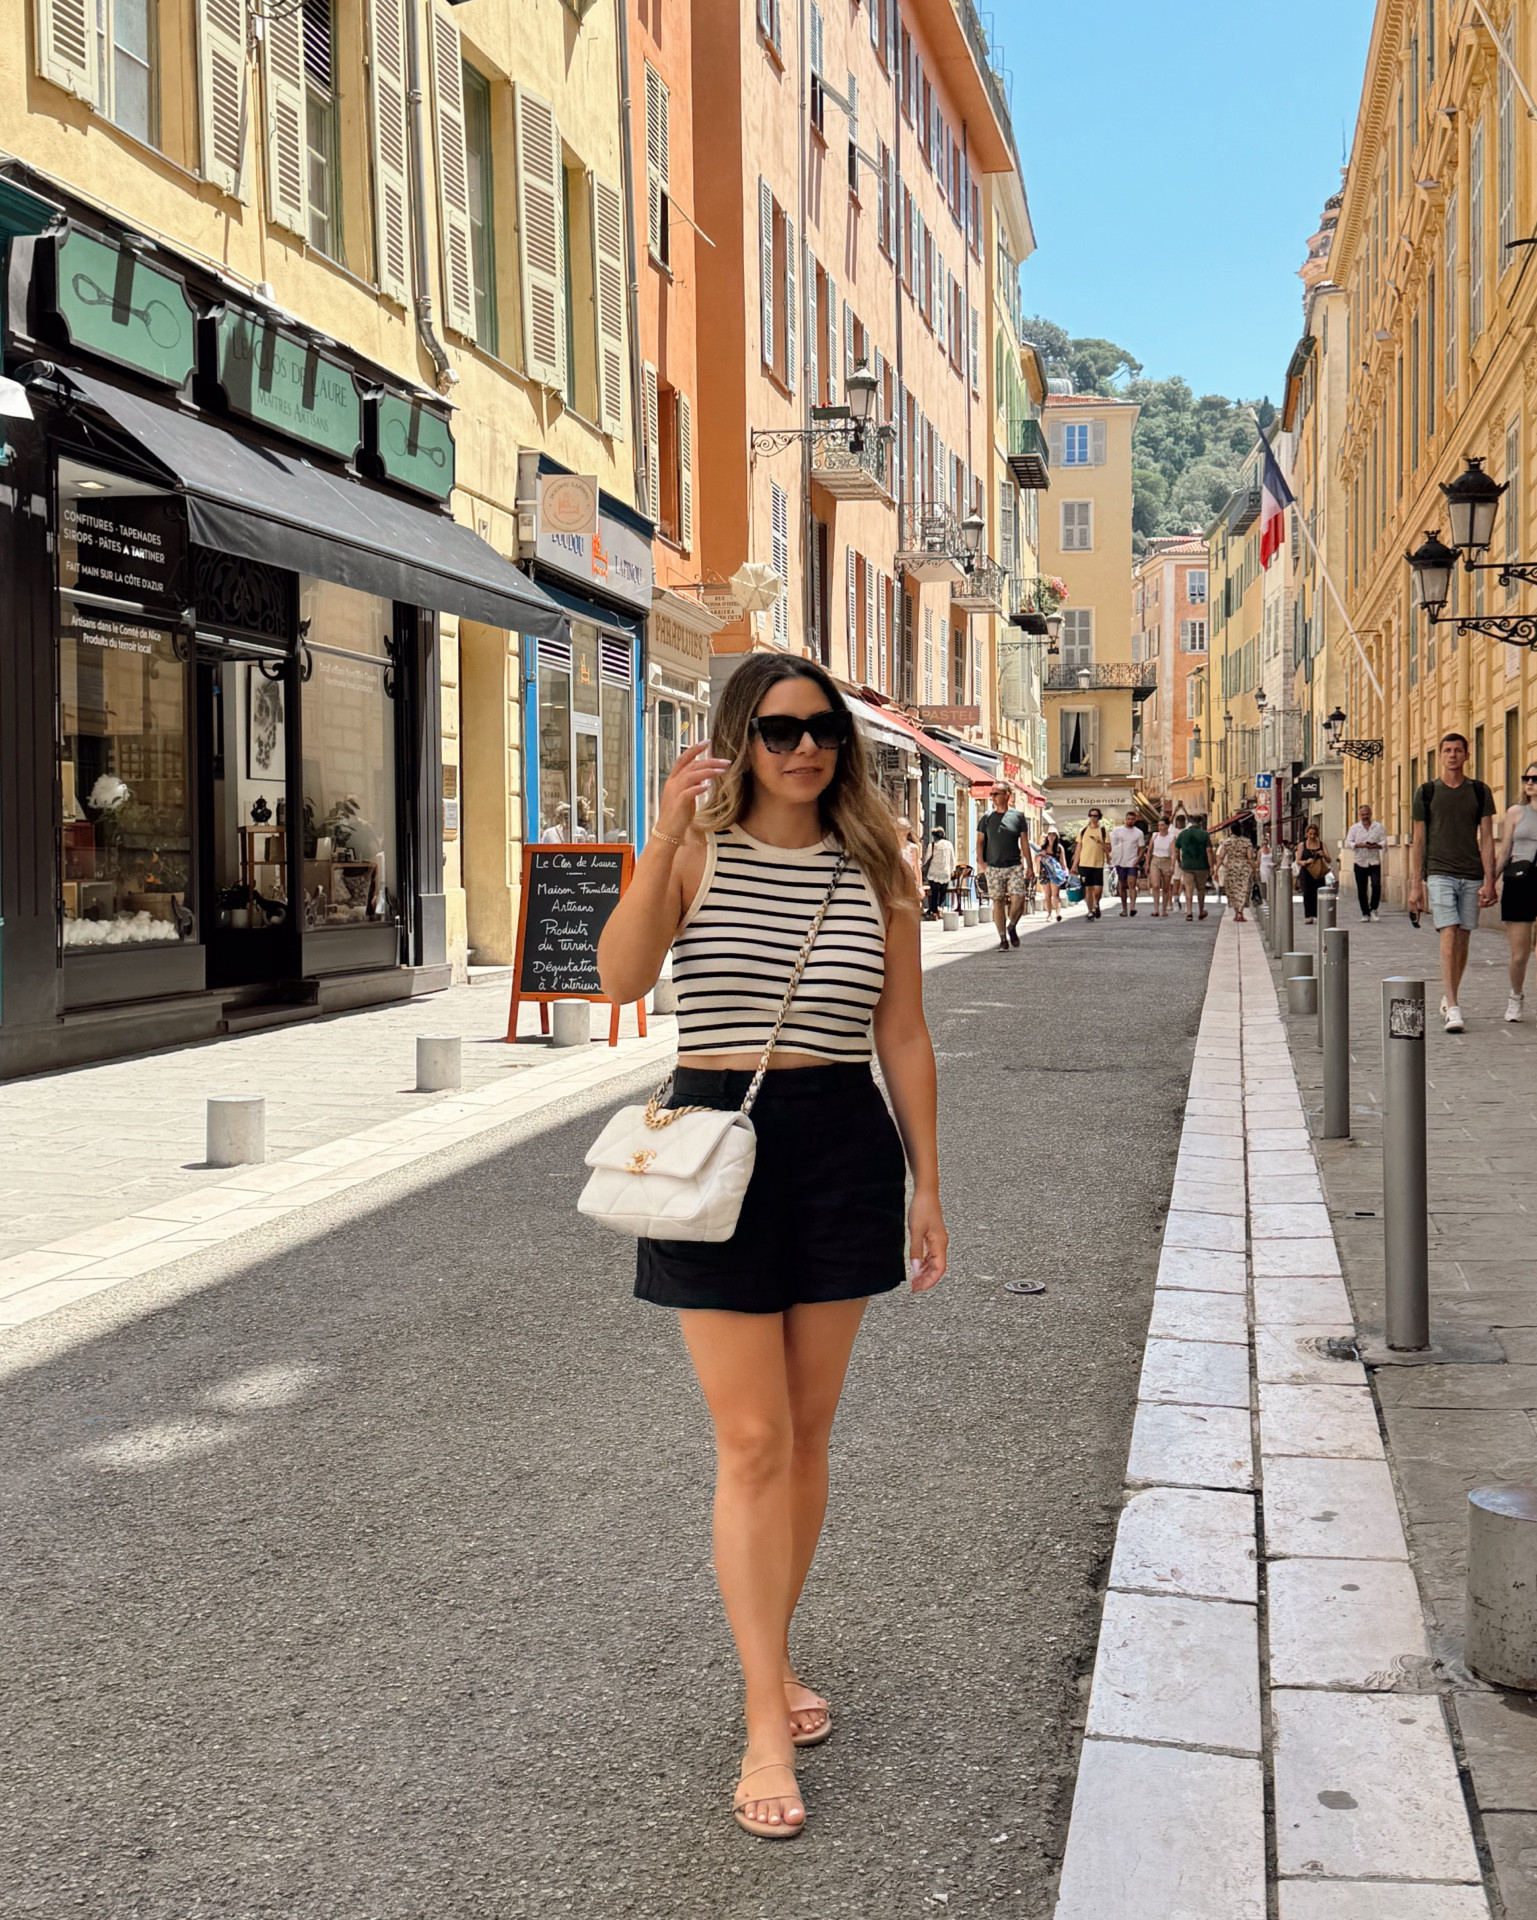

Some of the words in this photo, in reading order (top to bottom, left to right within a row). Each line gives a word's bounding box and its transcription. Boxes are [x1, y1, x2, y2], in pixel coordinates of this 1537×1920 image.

[232, 326, 249, 360] LE
[291, 362, 305, 387] DE
[311, 365, 347, 408] LAURE
[63, 509, 114, 533] CONFITURES
[119, 524, 162, 546] TAPENADES
[63, 528, 93, 545] SIROPS
[99, 536, 122, 553] PÂTES
[131, 545, 165, 564] TARTINER
[65, 560, 80, 573] FAIT
[81, 565, 99, 577] MAIN
[100, 568, 113, 581] SUR
[114, 572, 123, 583] LA
[124, 573, 141, 587] CÔTE
[141, 579, 164, 592] D'AZUR
[71, 615, 97, 630] Artisans
[97, 620, 112, 632] dans
[112, 622, 119, 634] le
[120, 624, 139, 637] Comté
[140, 628, 148, 639] de
[149, 630, 162, 641] Nice
[655, 613, 703, 661] PARAPLUIES
[82, 632, 108, 647] Produits
[109, 638, 118, 649] du
[118, 639, 137, 651] terroir
[138, 642, 152, 654] local
[921, 710, 978, 721] PASTEL
[1080, 797, 1126, 805] Tapenade
[536, 853, 549, 869] Le
[552, 853, 572, 869] Clos
[576, 855, 588, 867] de
[591, 854, 618, 868] Laure
[537, 883, 576, 896] Maison
[577, 881, 619, 894] Familiale
[551, 899, 594, 912] Artisans
[540, 918, 588, 936] Produits
[537, 937, 554, 951] du
[532, 957, 598, 977] Dégustation
[538, 976, 546, 990] à
[551, 975, 601, 990] l'intérieur
